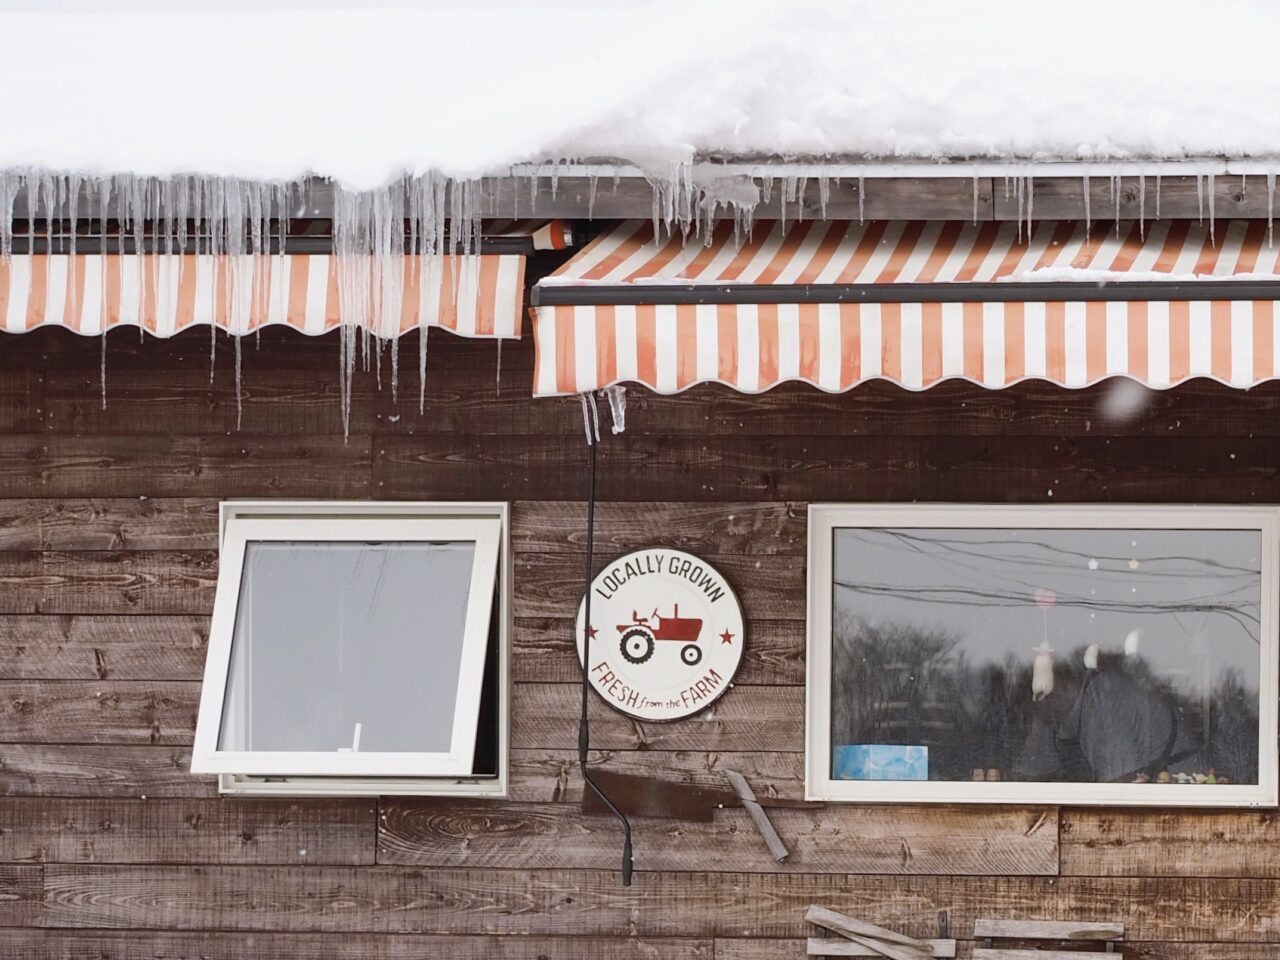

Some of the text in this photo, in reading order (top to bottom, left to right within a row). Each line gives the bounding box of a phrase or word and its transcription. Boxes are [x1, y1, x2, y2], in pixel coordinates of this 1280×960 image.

[595, 554, 725, 603] LOCALLY GROWN
[591, 661, 723, 709] FRESH from the FARM
